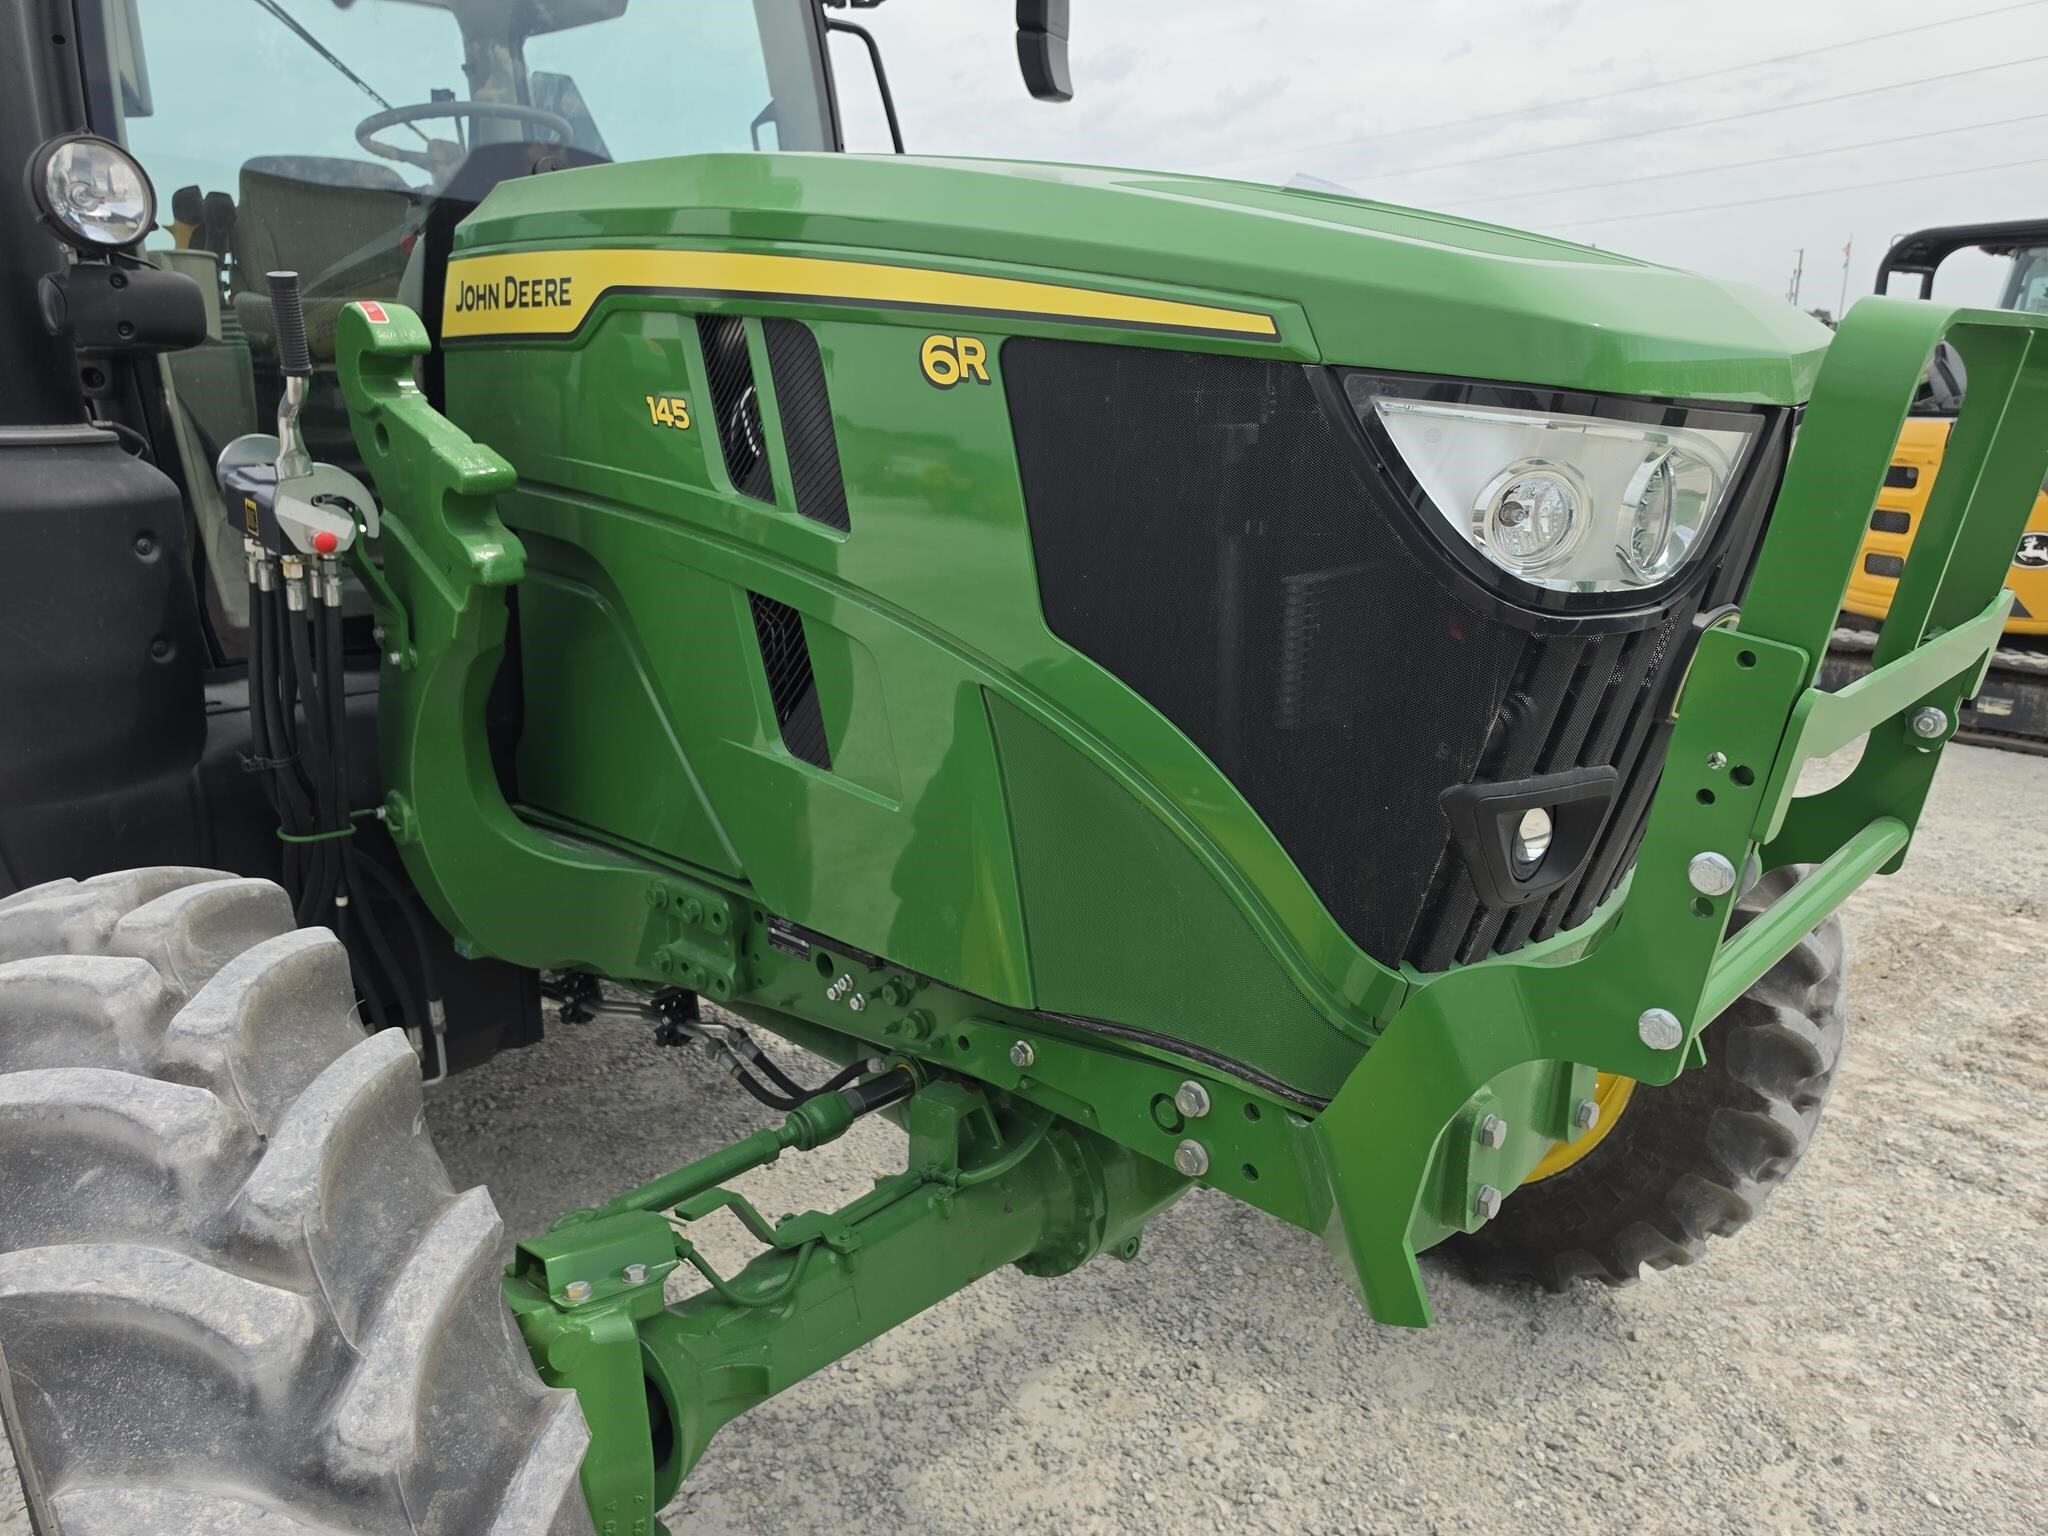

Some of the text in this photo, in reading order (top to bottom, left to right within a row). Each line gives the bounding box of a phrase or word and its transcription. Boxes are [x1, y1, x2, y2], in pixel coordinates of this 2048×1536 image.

[455, 275, 572, 313] JOHN DEERE
[920, 333, 991, 390] 6R
[645, 394, 691, 430] 145
